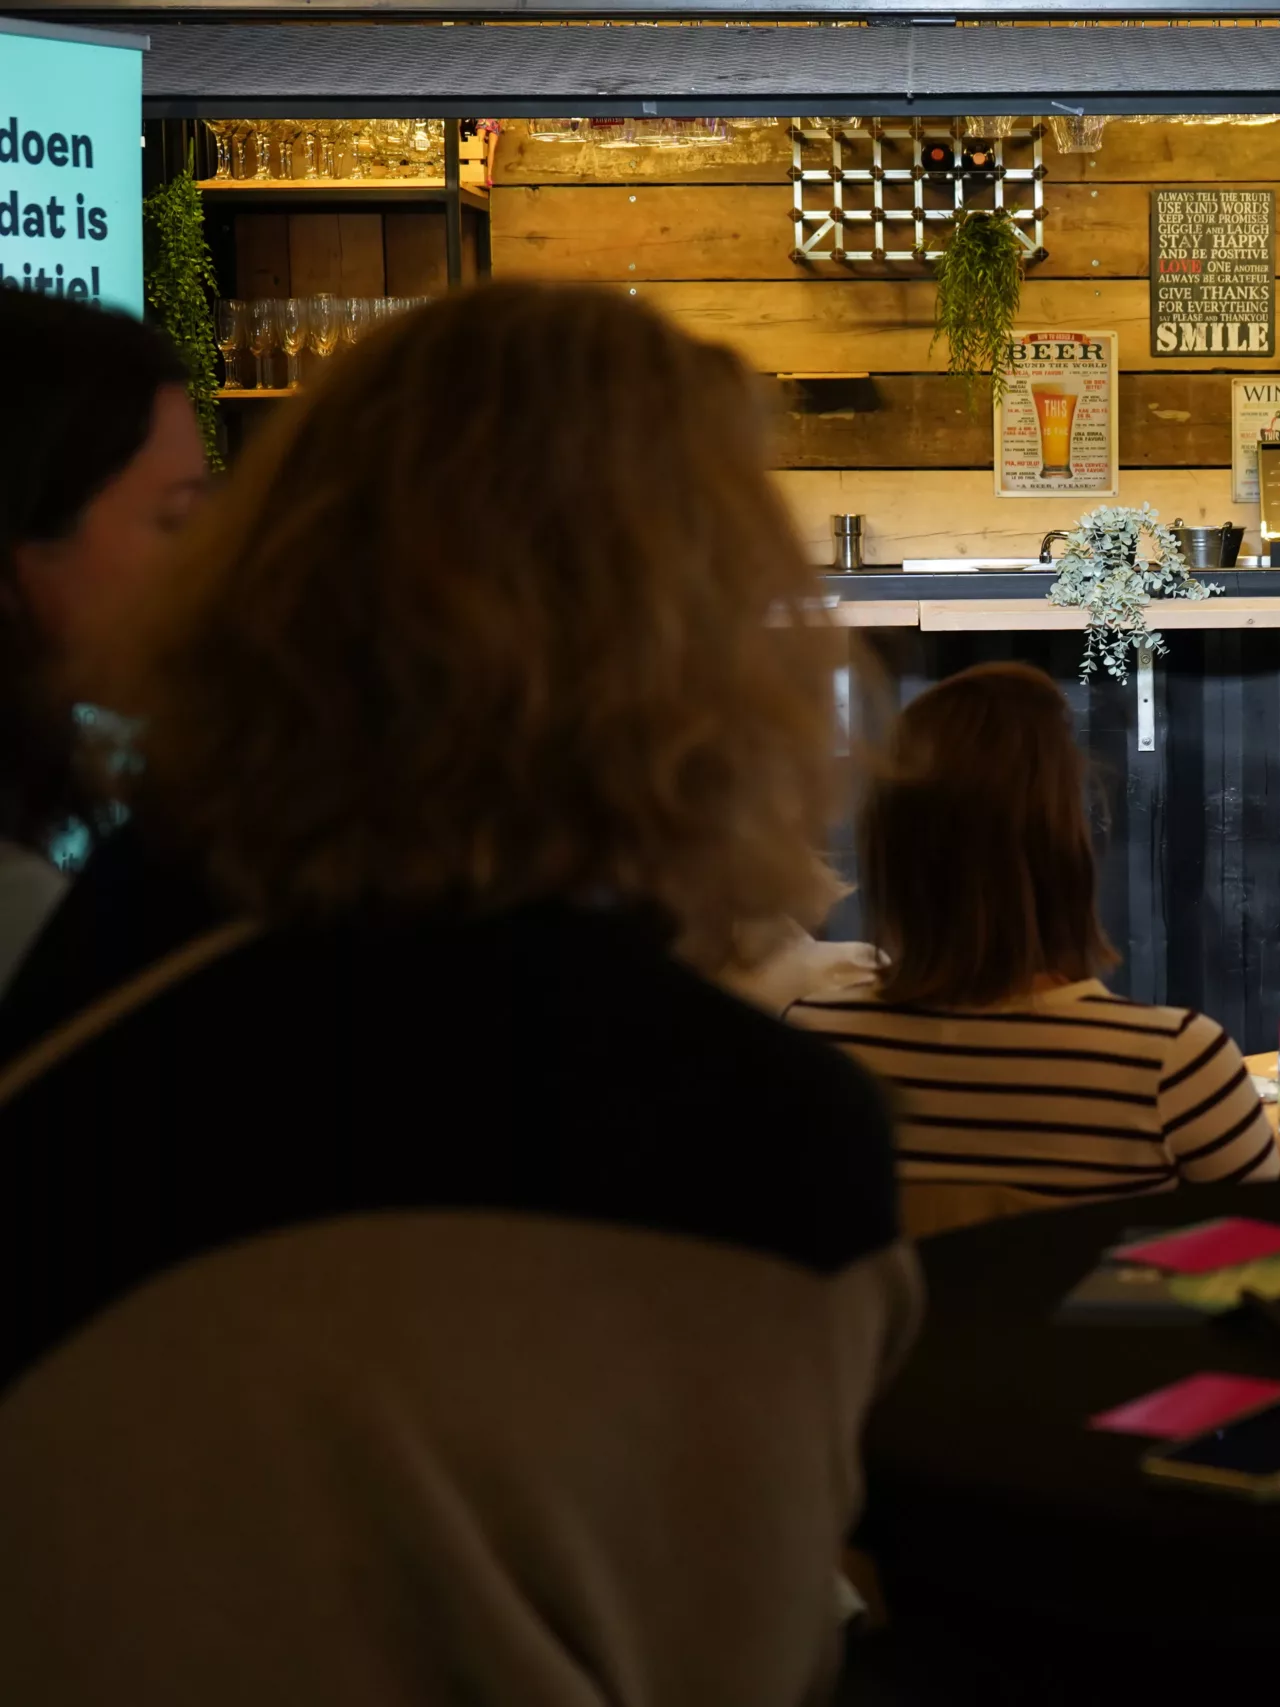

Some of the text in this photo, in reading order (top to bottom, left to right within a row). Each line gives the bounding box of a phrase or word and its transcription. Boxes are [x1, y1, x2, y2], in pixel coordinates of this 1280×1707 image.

[0, 117, 93, 168] doen
[1157, 193, 1271, 202] ALWAYS TELL THE TRUTH
[1158, 202, 1269, 214] USE KIND WORDS
[0, 191, 108, 241] dat is
[1159, 215, 1268, 223] KEEP YOUR PROMISES
[1158, 224, 1202, 234] GIGGLE
[1227, 224, 1269, 234] LAUGH
[1159, 235, 1268, 248] STAY HAPPY
[1159, 249, 1268, 259] AND BE POSITIVE
[1159, 260, 1269, 273] LOVE ONE ANOTHER
[1159, 274, 1269, 283] ALWAYS BE GRATEFUL
[1159, 286, 1269, 300] GIVE THANKS
[1159, 301, 1268, 313] FOR EVERYTHING
[1173, 314, 1203, 322] PLEASE
[1220, 314, 1268, 322] THANKYOU
[1157, 323, 1268, 351] SMILE
[1005, 344, 1104, 360] BEER
[1045, 400, 1067, 417] THIS
